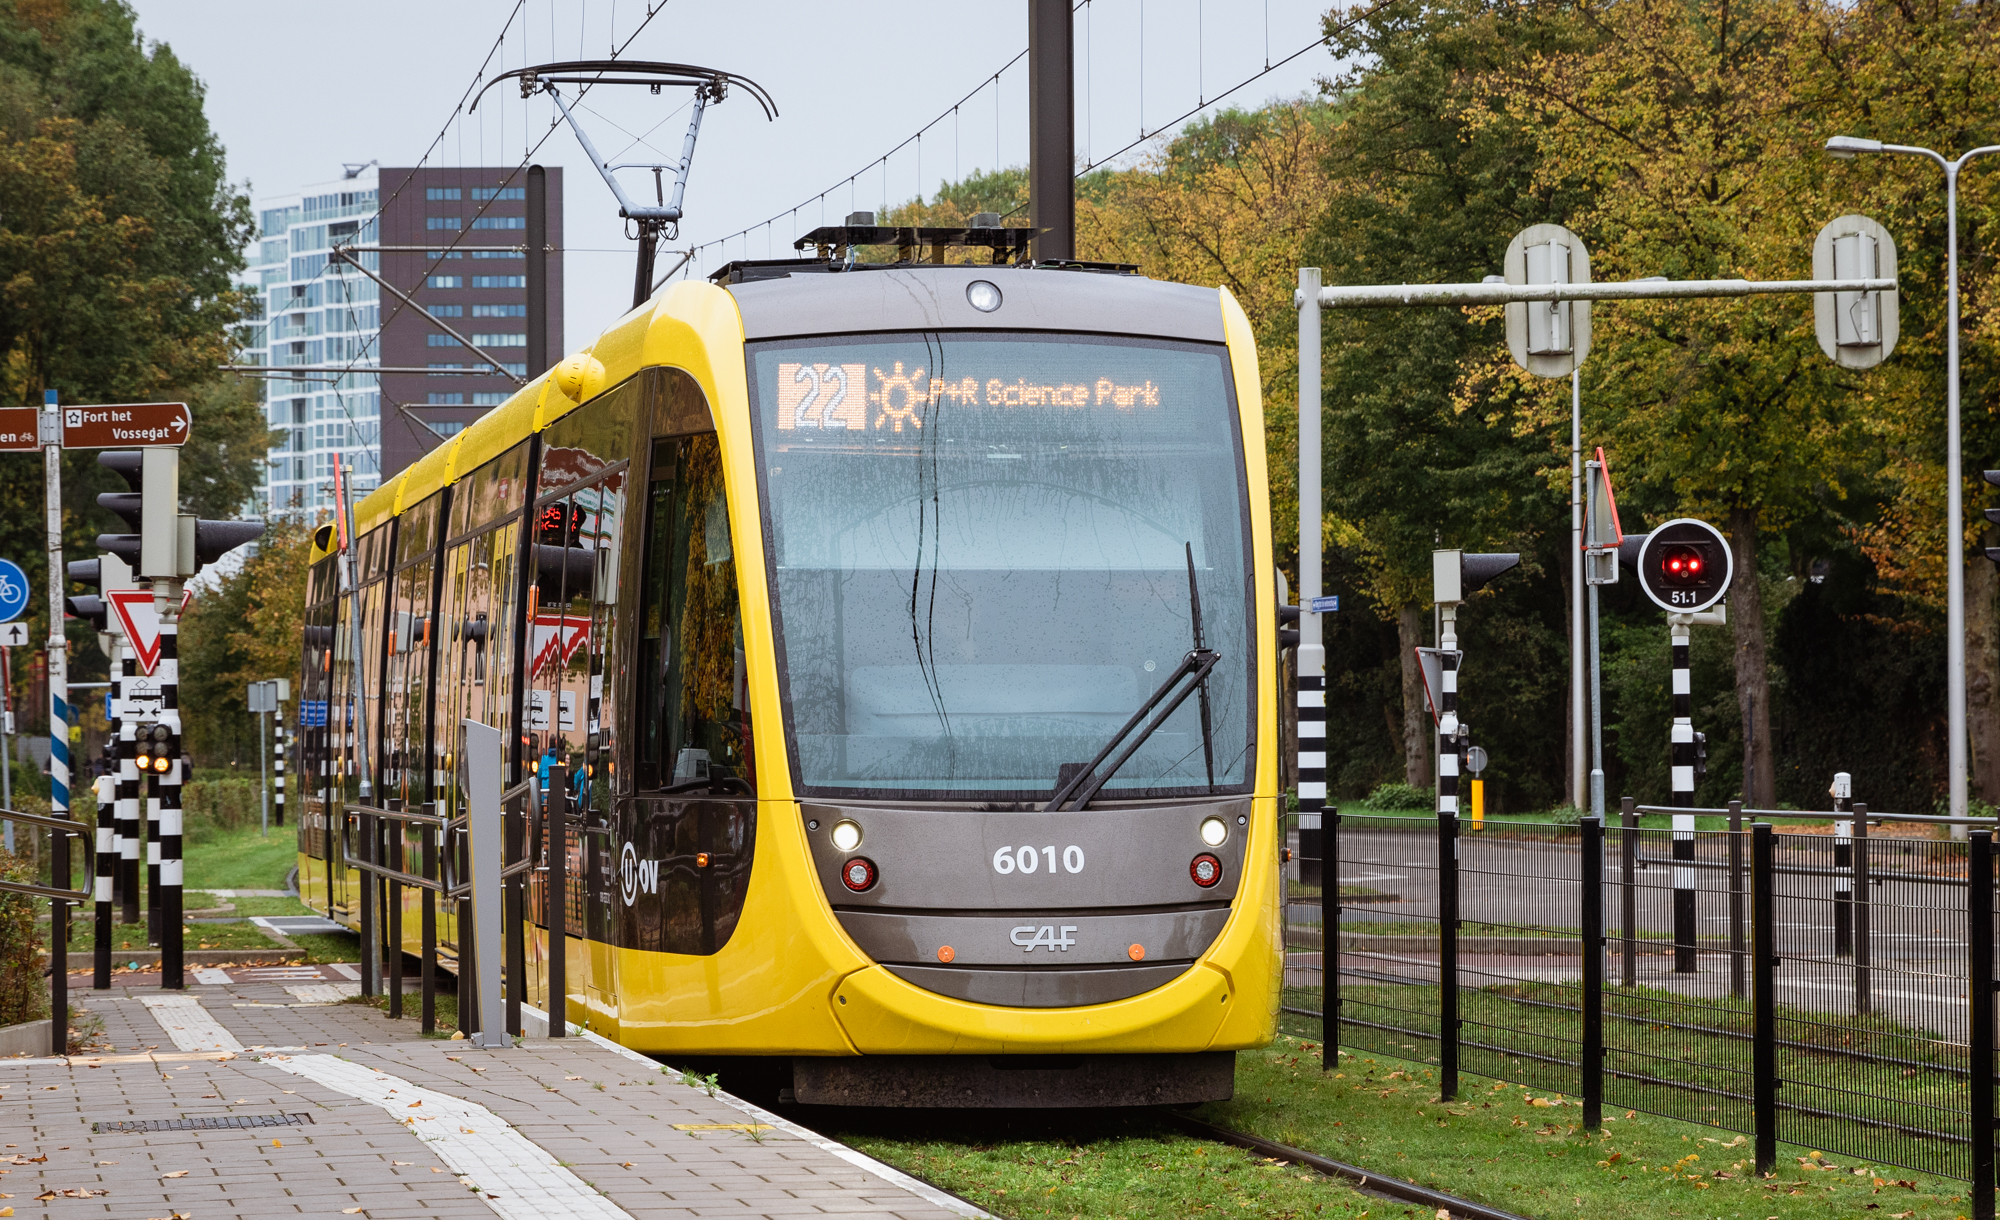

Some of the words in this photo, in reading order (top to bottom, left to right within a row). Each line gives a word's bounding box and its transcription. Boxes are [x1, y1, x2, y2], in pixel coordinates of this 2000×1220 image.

[794, 364, 848, 428] 22
[929, 378, 979, 406] P+R
[986, 376, 1090, 407] Science
[1094, 376, 1161, 407] Park
[83, 411, 108, 423] Fort
[111, 410, 132, 422] het
[0, 433, 17, 442] en
[112, 427, 170, 441] Vossegat
[1671, 591, 1697, 604] 51.1
[992, 845, 1085, 875] 6010
[638, 858, 659, 894] OV
[1009, 925, 1078, 952] CAF
